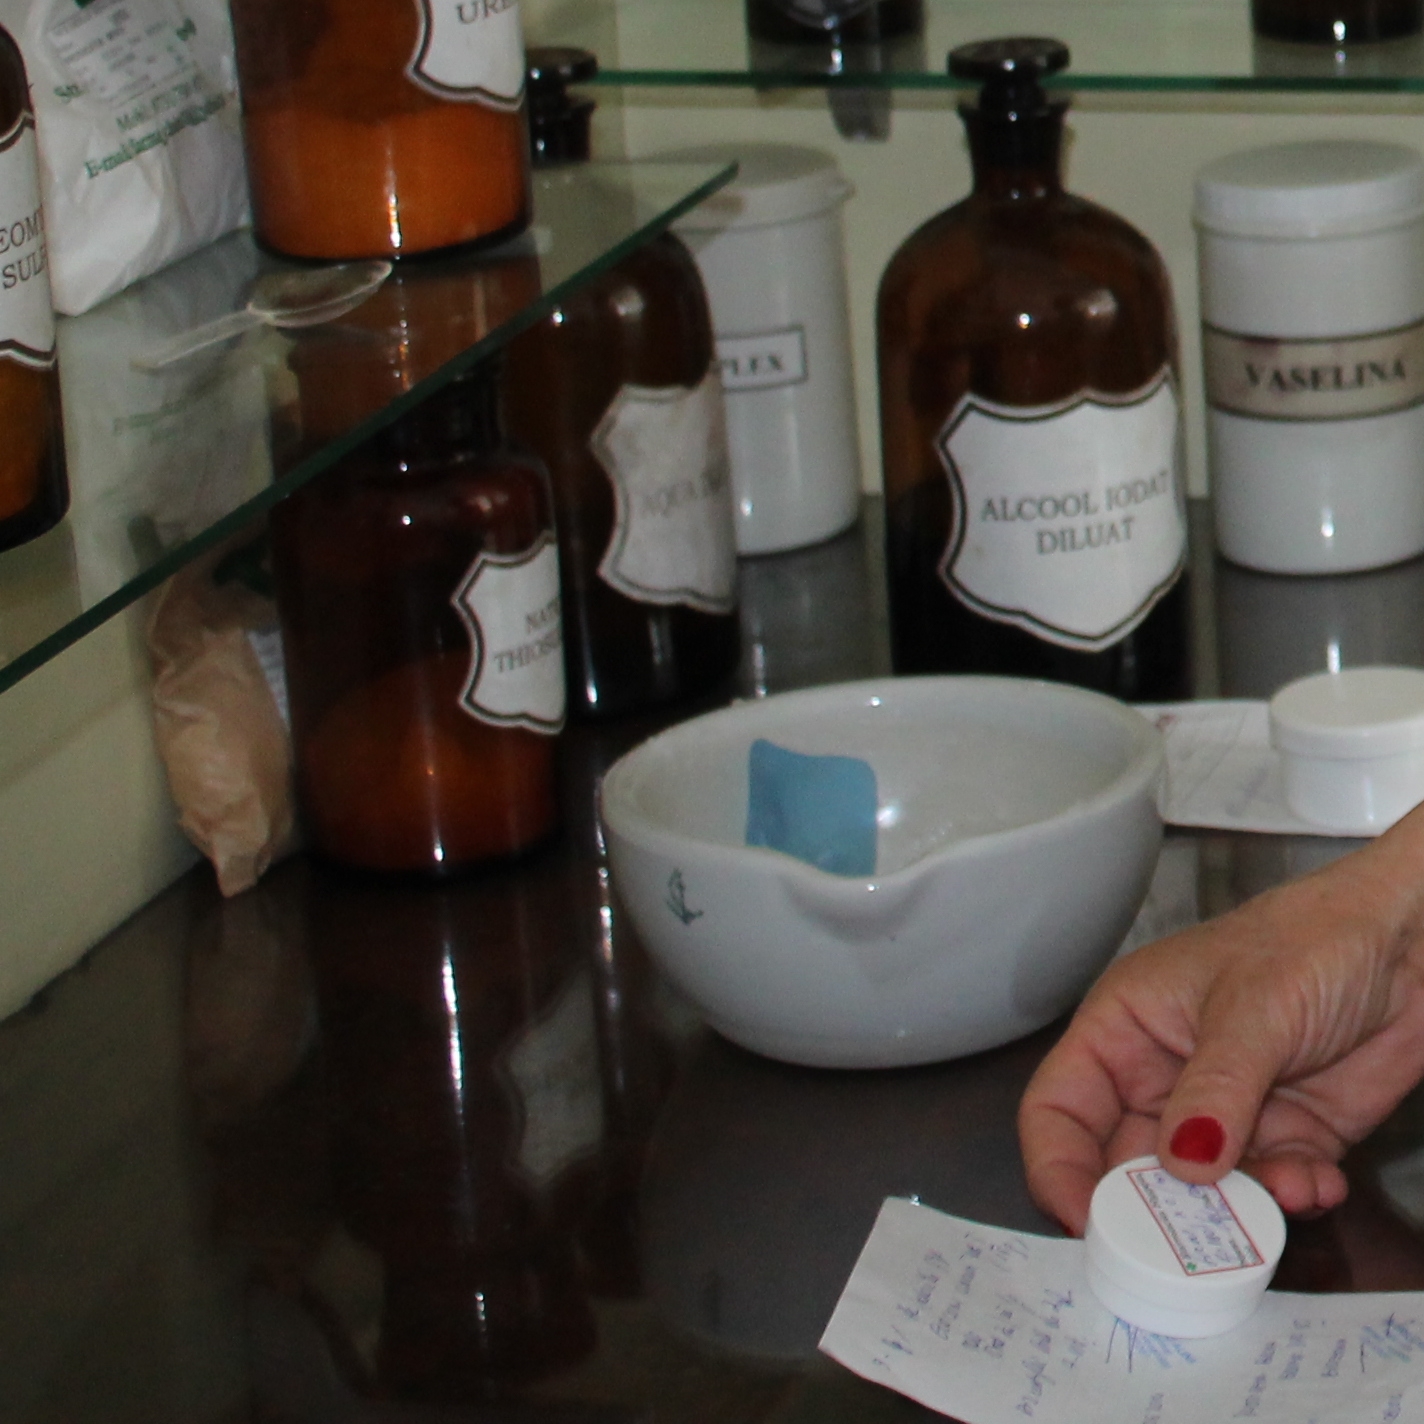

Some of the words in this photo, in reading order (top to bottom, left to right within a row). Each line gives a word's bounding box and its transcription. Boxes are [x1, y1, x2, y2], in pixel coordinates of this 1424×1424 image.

[1244, 358, 1407, 392] VASELINA
[980, 489, 1099, 522] ALCOOL
[1105, 468, 1168, 511] IODAT
[1036, 514, 1136, 555] DILUAT
